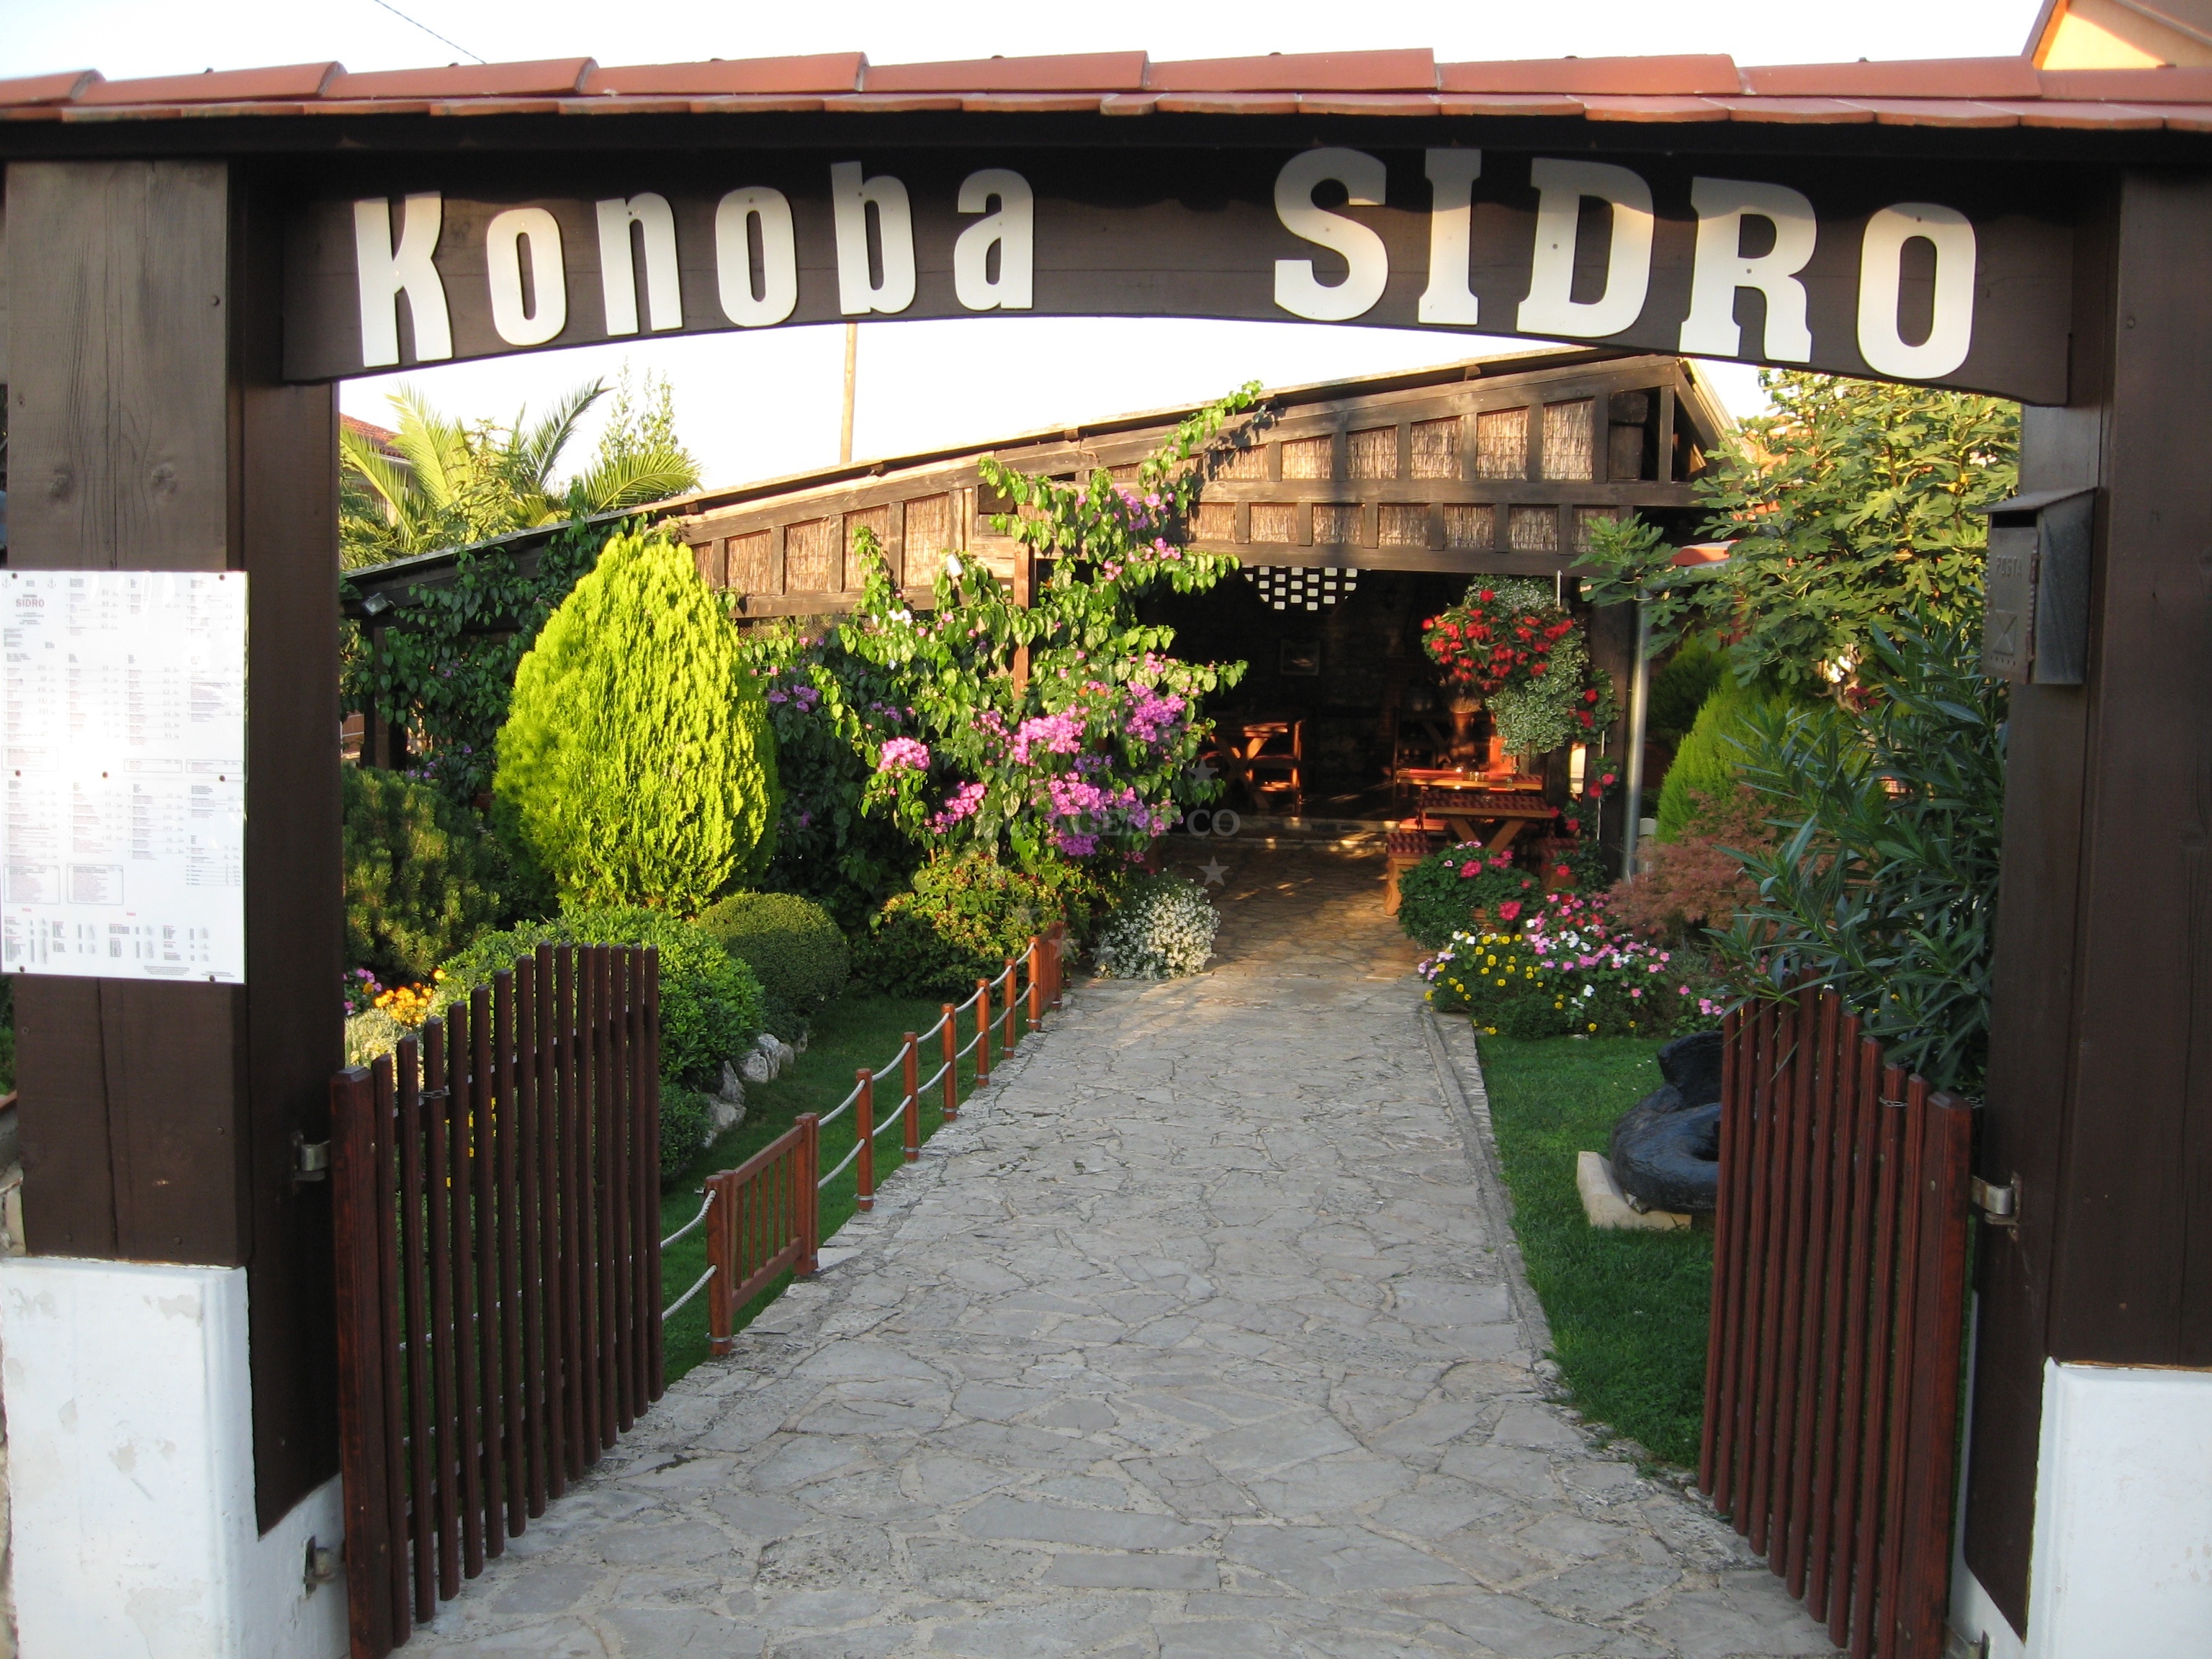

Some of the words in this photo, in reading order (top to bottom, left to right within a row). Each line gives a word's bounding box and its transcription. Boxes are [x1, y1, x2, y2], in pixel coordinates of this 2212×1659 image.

[354, 161, 1034, 367] Konoba
[1274, 147, 1977, 380] SIDRO
[15, 598, 45, 607] SIDRO
